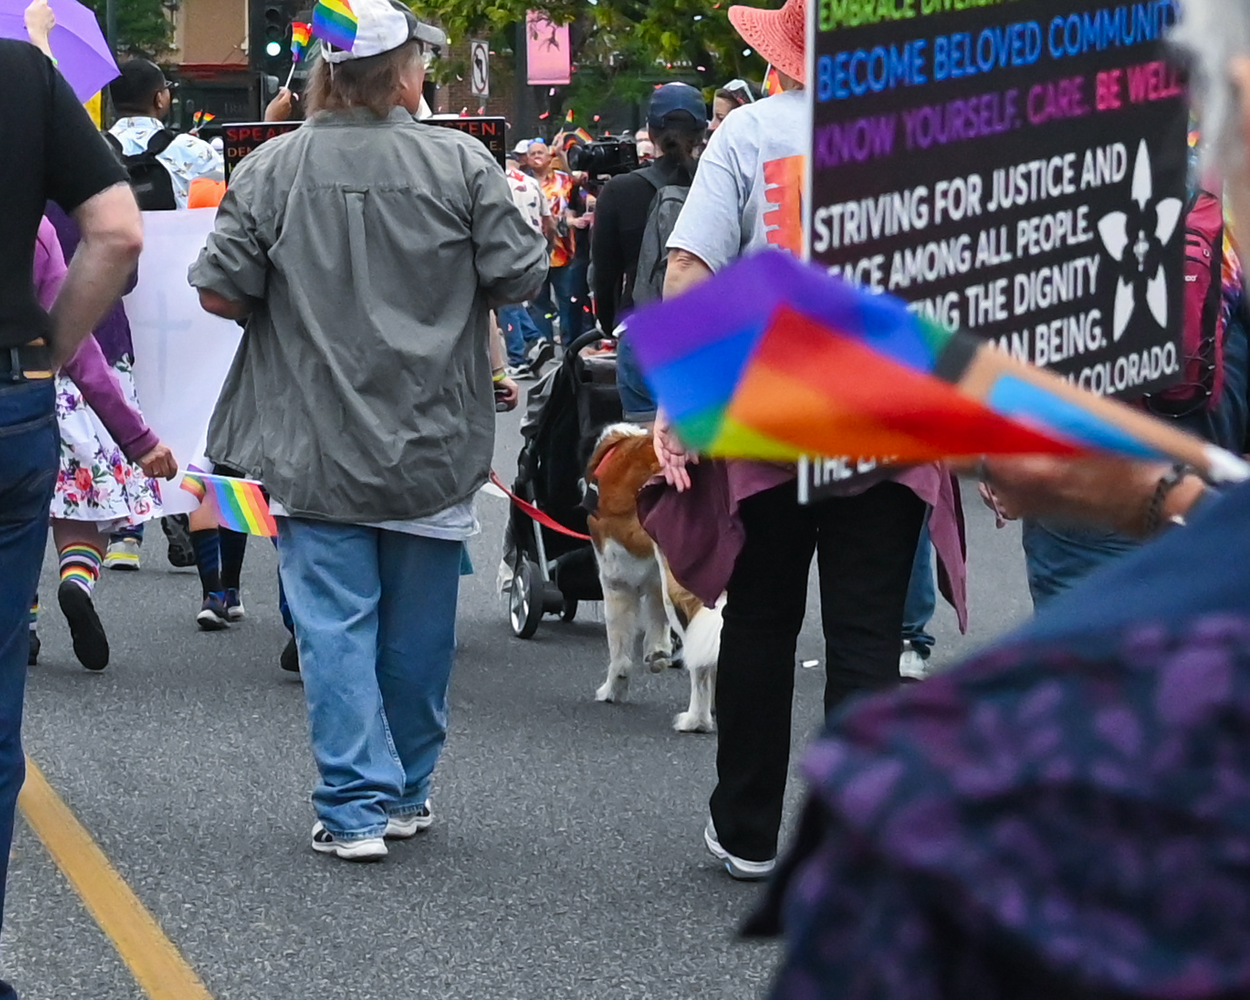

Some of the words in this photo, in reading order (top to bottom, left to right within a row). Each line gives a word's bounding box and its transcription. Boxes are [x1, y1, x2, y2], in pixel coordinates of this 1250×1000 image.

[817, 38, 927, 101] BECOME
[934, 20, 1041, 81] BELOVED
[815, 115, 896, 170] KNOW
[903, 89, 1021, 150] YOURSELF.
[1096, 68, 1121, 110] BE
[813, 186, 928, 252] STRIVING
[935, 173, 982, 231] FOR
[987, 152, 1076, 212] JUSTICE
[1080, 142, 1127, 190] AND
[888, 233, 971, 291] AMONG
[974, 224, 1013, 269] ALL
[1017, 204, 1094, 258] PEOPLE.
[965, 277, 1009, 329] THE
[1013, 253, 1100, 316] DIGNITY
[1034, 308, 1108, 367] BEING.
[1078, 340, 1180, 397] COLORADO.
